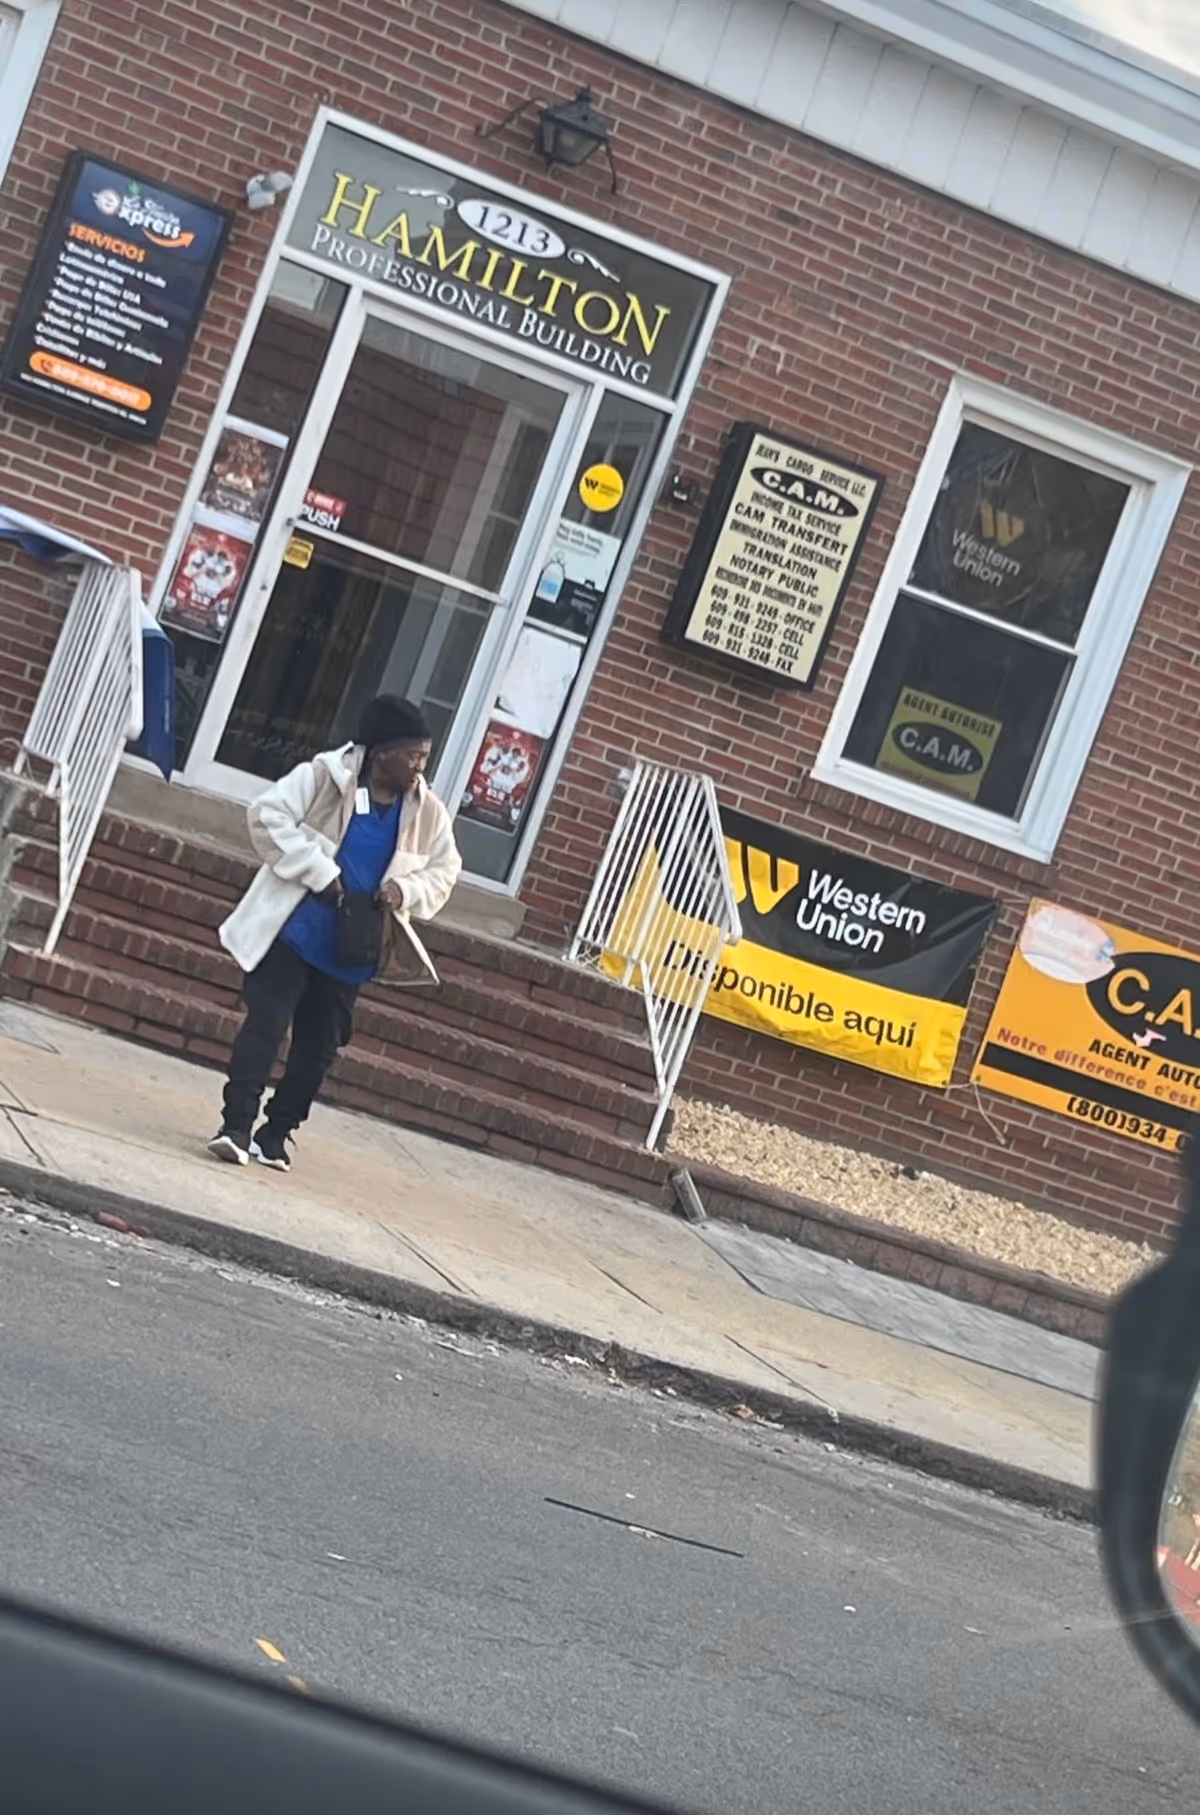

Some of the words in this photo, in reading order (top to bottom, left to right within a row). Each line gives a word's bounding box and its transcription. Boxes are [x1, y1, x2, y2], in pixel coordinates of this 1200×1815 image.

[69, 222, 146, 263] SERVICIOS
[476, 206, 550, 254] 1213
[319, 171, 671, 357] HAMILTON
[310, 224, 512, 330] PROFESSIONAL
[518, 308, 652, 385] BUILDING
[786, 456, 814, 476] CARGO
[762, 471, 844, 515] C.A.M.
[299, 505, 341, 532] PUSH
[734, 502, 765, 524] CAM
[771, 516, 848, 556] TRANSFERT
[787, 505, 803, 521] TAX
[805, 512, 841, 537] SERVICE
[743, 541, 818, 580] TRANSLATION
[953, 528, 1021, 577] Western
[953, 548, 1003, 588] Union
[729, 554, 775, 581] NOTARY
[777, 572, 819, 598] PUBLIC
[783, 628, 804, 646] CELL
[784, 612, 816, 634] OFFICE
[775, 657, 794, 674] FAX
[778, 642, 799, 660] CELL
[903, 692, 939, 717] AGENT
[900, 727, 974, 772] C.A.M.
[808, 869, 925, 935] Western
[796, 898, 885, 953] Union
[843, 1010, 917, 1048] aquí
[997, 1027, 1047, 1055] Notre
[1088, 1038, 1152, 1071] AGENT
